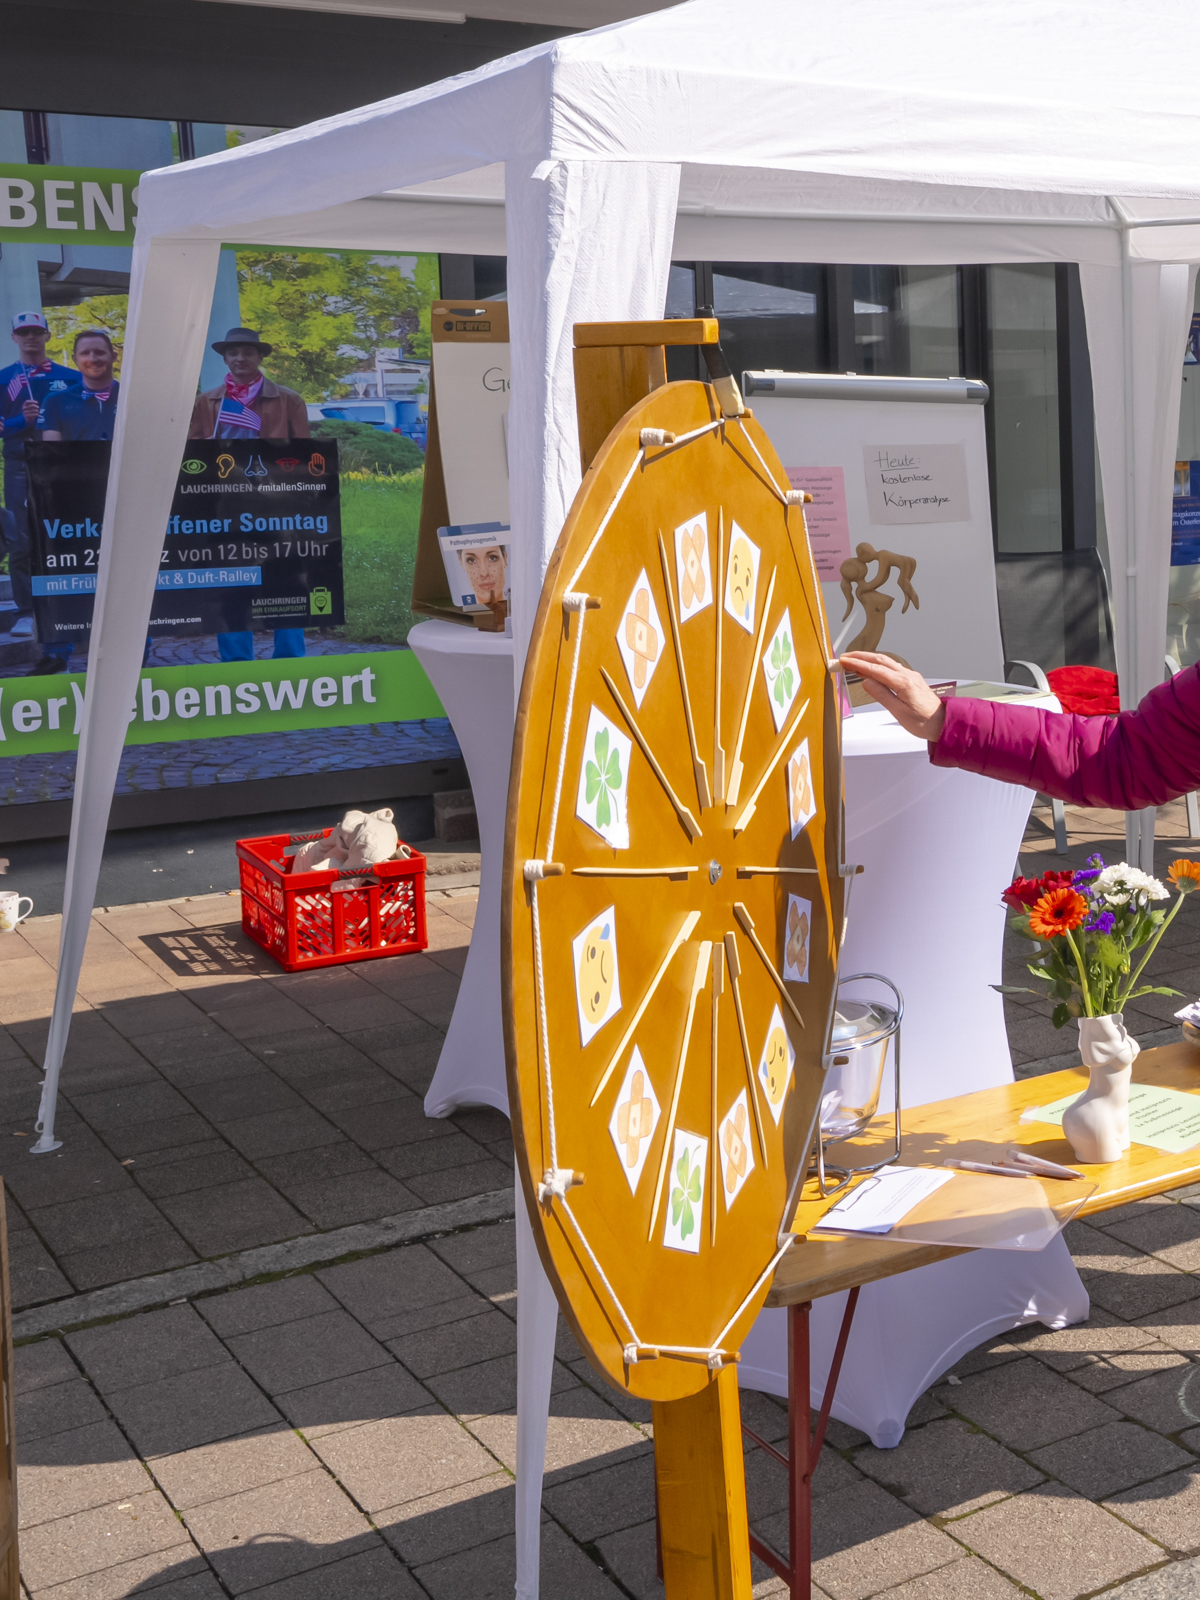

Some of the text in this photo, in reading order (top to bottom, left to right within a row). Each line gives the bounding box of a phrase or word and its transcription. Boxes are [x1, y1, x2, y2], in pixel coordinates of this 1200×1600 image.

[0, 177, 139, 232] BEN
[880, 473, 933, 485] kostenlose
[180, 481, 327, 494] LAUCHRINGEN #mitallenSinnen
[239, 512, 329, 535] Sonntag
[46, 553, 77, 567] am
[178, 549, 212, 562] von
[217, 543, 238, 560] 12
[242, 542, 269, 560] bis
[273, 541, 292, 558] 17
[296, 540, 329, 558] Uhr
[46, 578, 68, 591] mit
[173, 573, 184, 585] &
[187, 570, 258, 584] Duft-Ralley
[251, 596, 307, 606] LAUCHRINGEN
[54, 623, 85, 631] Weitere
[149, 616, 202, 626] uchringen.com
